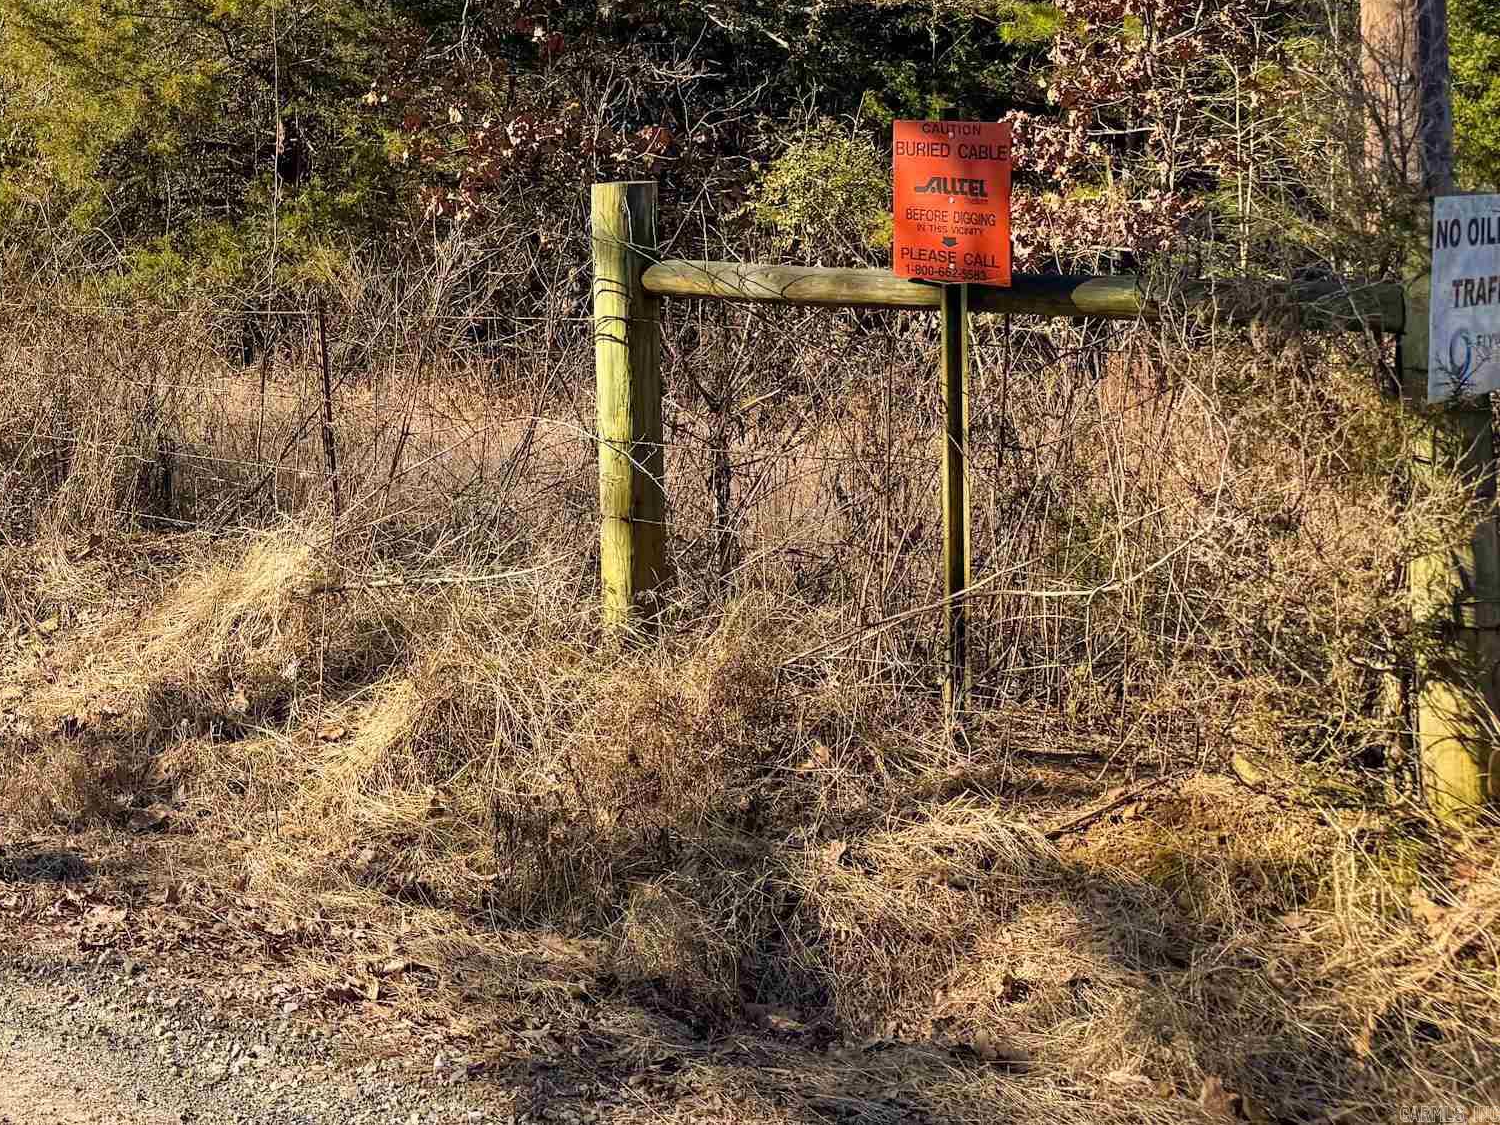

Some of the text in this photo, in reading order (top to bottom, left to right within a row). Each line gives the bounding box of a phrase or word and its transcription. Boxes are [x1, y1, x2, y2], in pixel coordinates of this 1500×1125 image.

[922, 123, 980, 135] CAUTION
[896, 141, 1007, 161] BURIED CABLE
[906, 208, 996, 226] BEFORE DIGGING
[1436, 216, 1500, 249] NO OIL
[900, 247, 1000, 268] PLEASE CALL
[1452, 276, 1500, 308] TRAF
